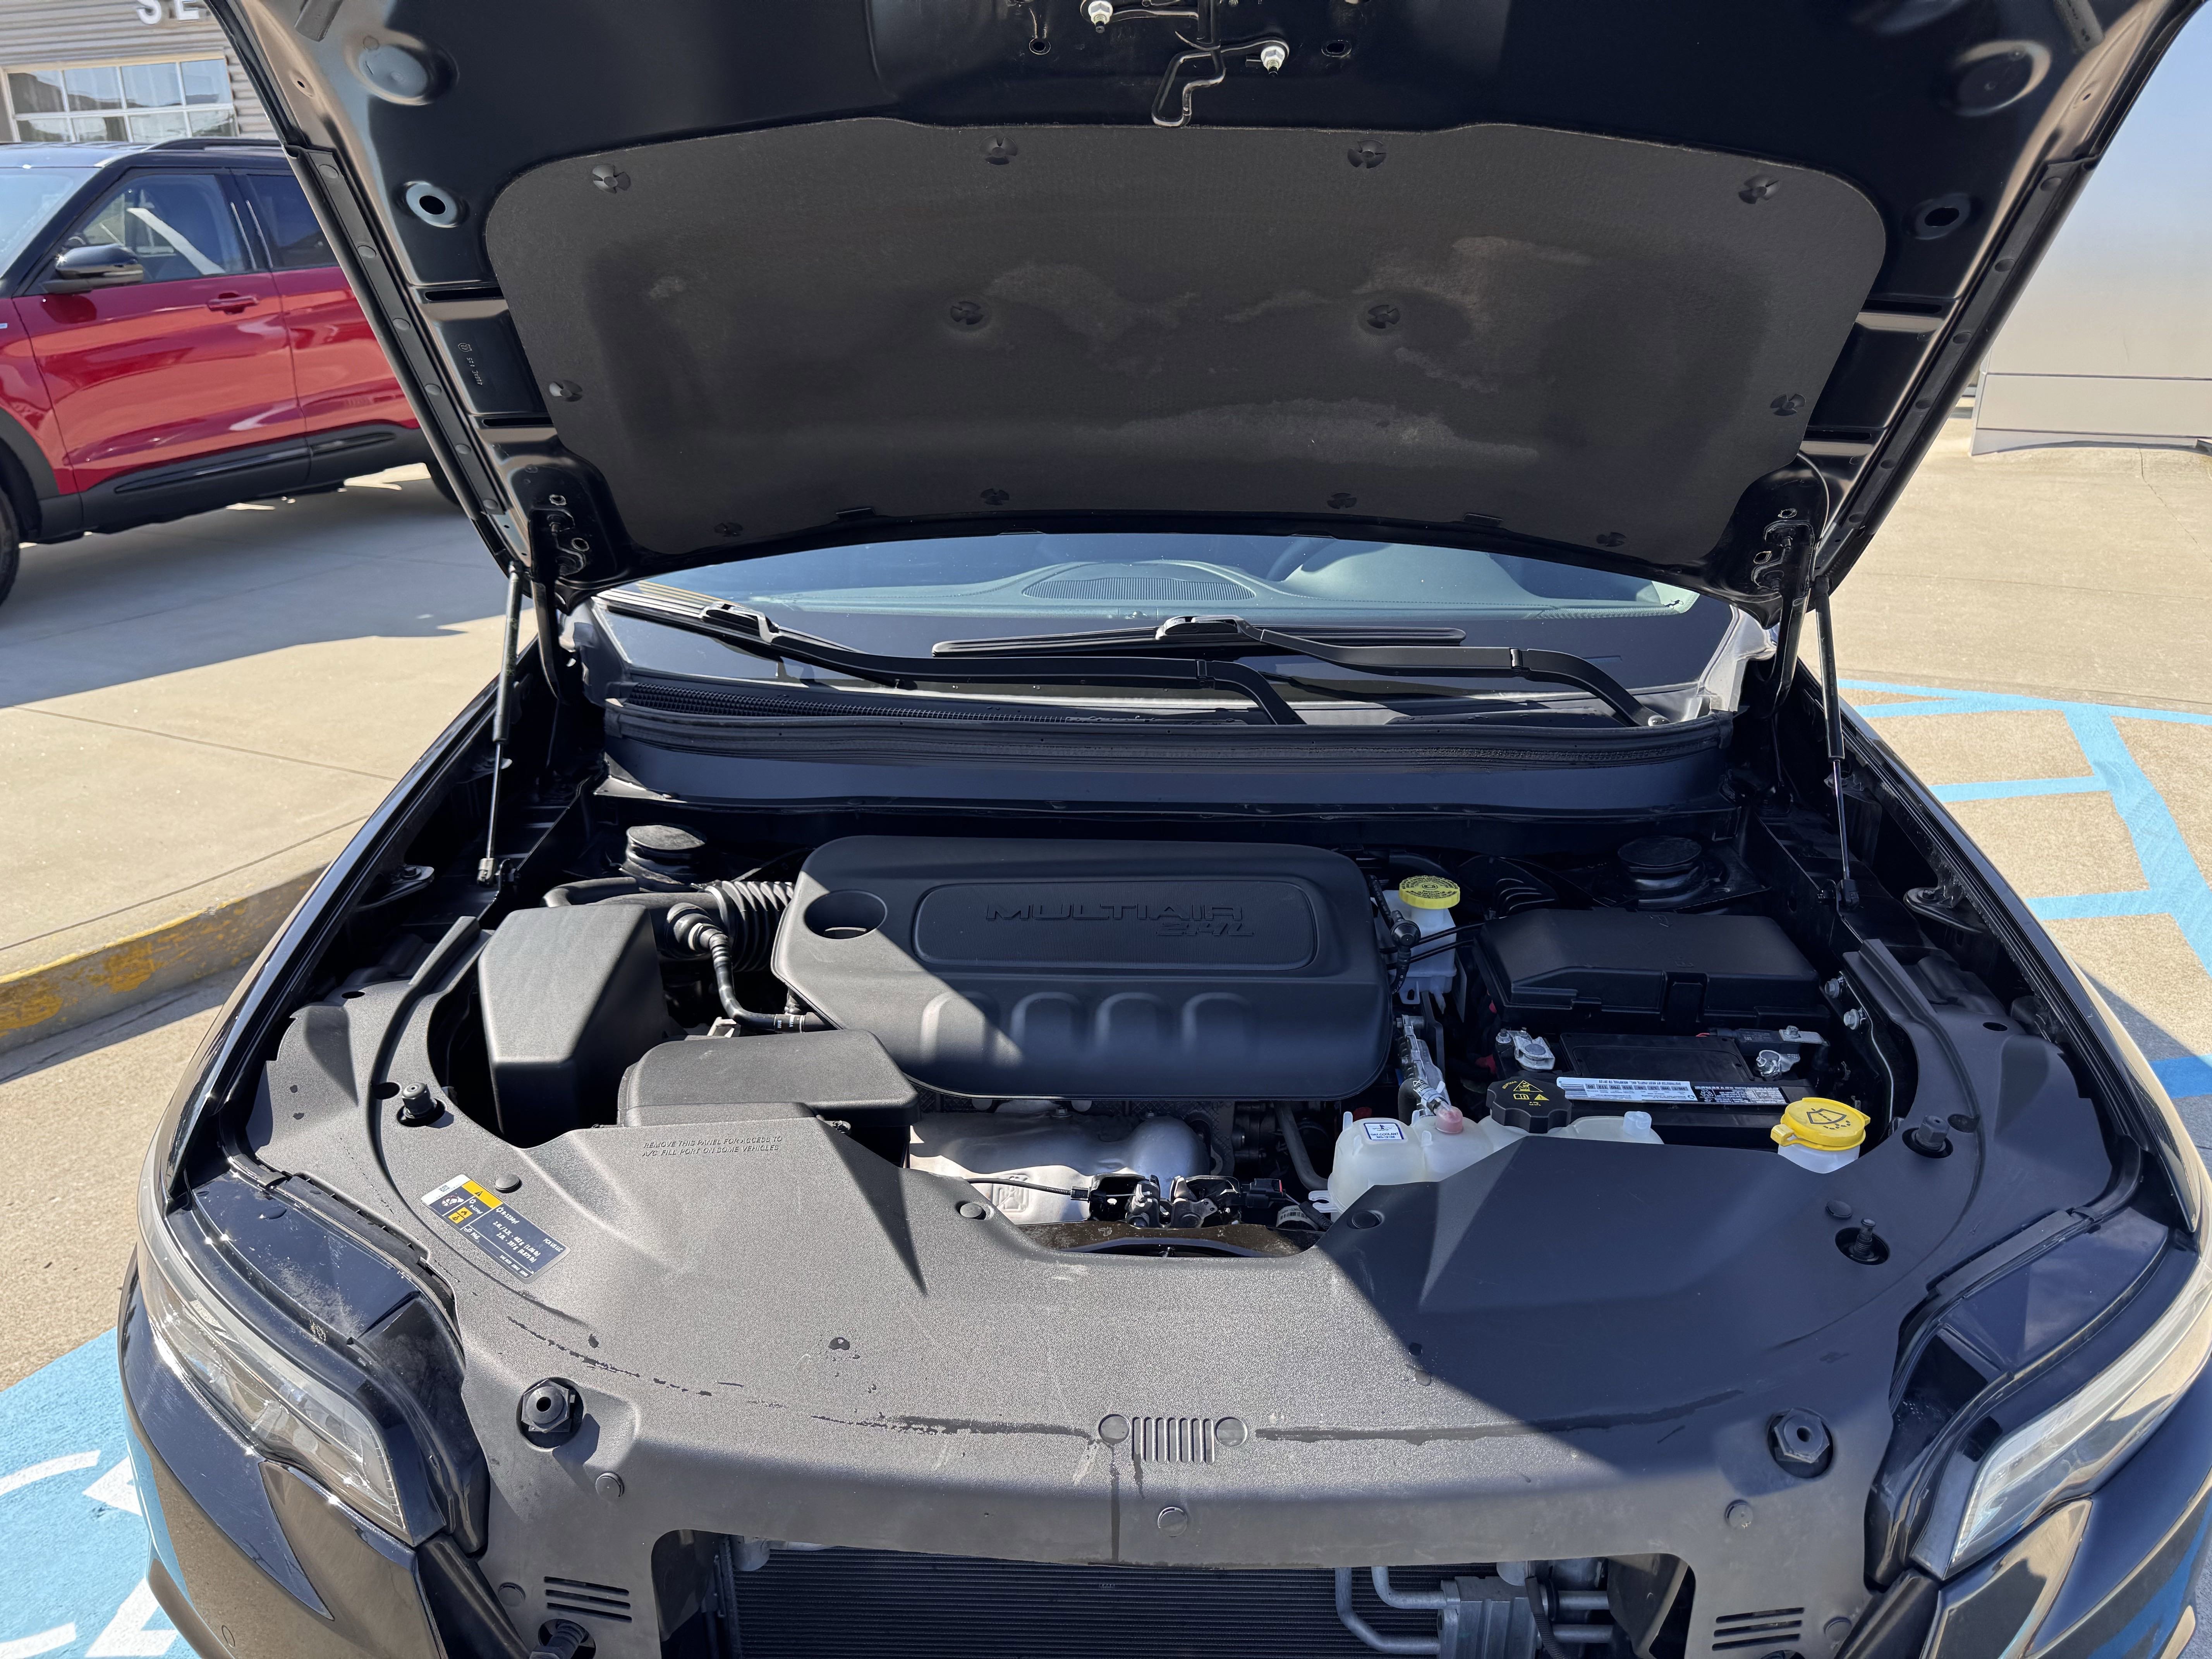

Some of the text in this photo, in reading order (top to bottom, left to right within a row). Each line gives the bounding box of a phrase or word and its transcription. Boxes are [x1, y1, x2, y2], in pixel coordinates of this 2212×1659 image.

[986, 904, 1243, 921] MULTIAIR
[1156, 922, 1254, 936] 2.4L
[470, 1232, 480, 1240] PAG
